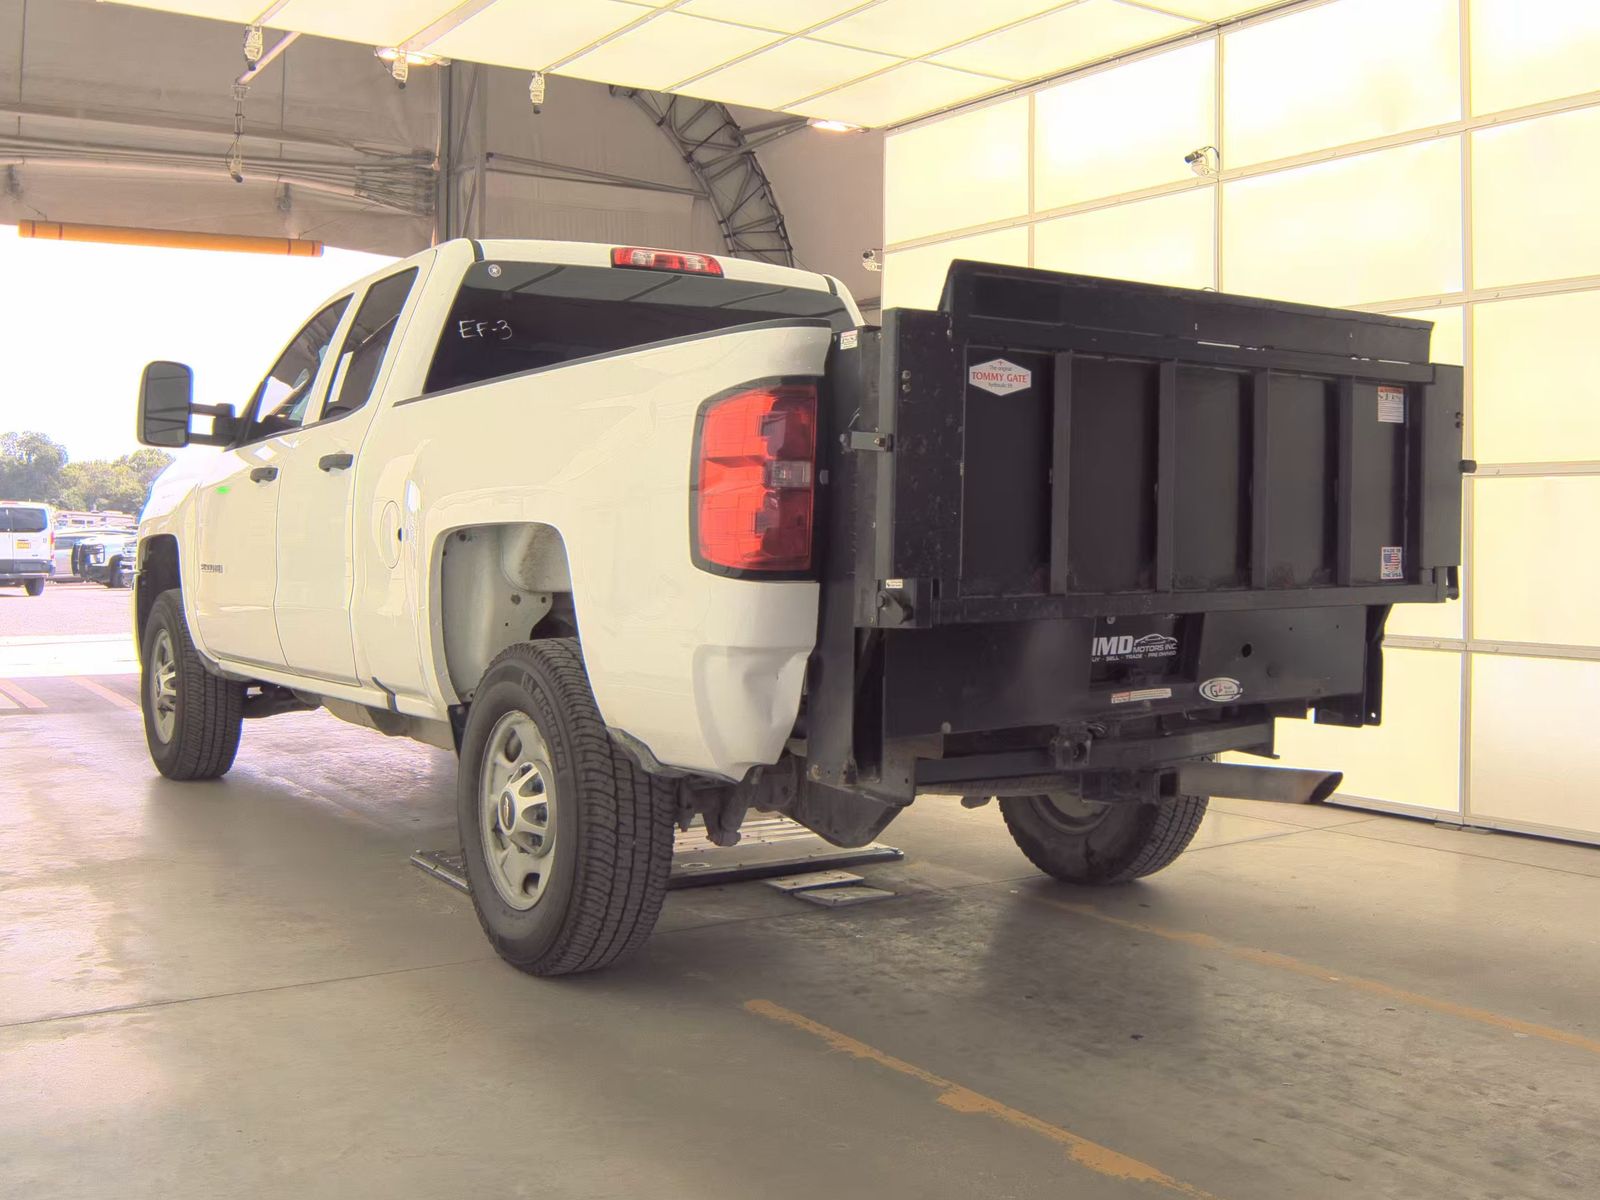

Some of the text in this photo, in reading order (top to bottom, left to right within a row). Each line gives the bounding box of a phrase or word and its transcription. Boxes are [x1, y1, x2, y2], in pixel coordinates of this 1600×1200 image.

[459, 319, 513, 341] EF-3
[971, 371, 1028, 384] TOMMY GATE
[1091, 635, 1134, 656] IMD
[1133, 644, 1164, 653] MOTORS
